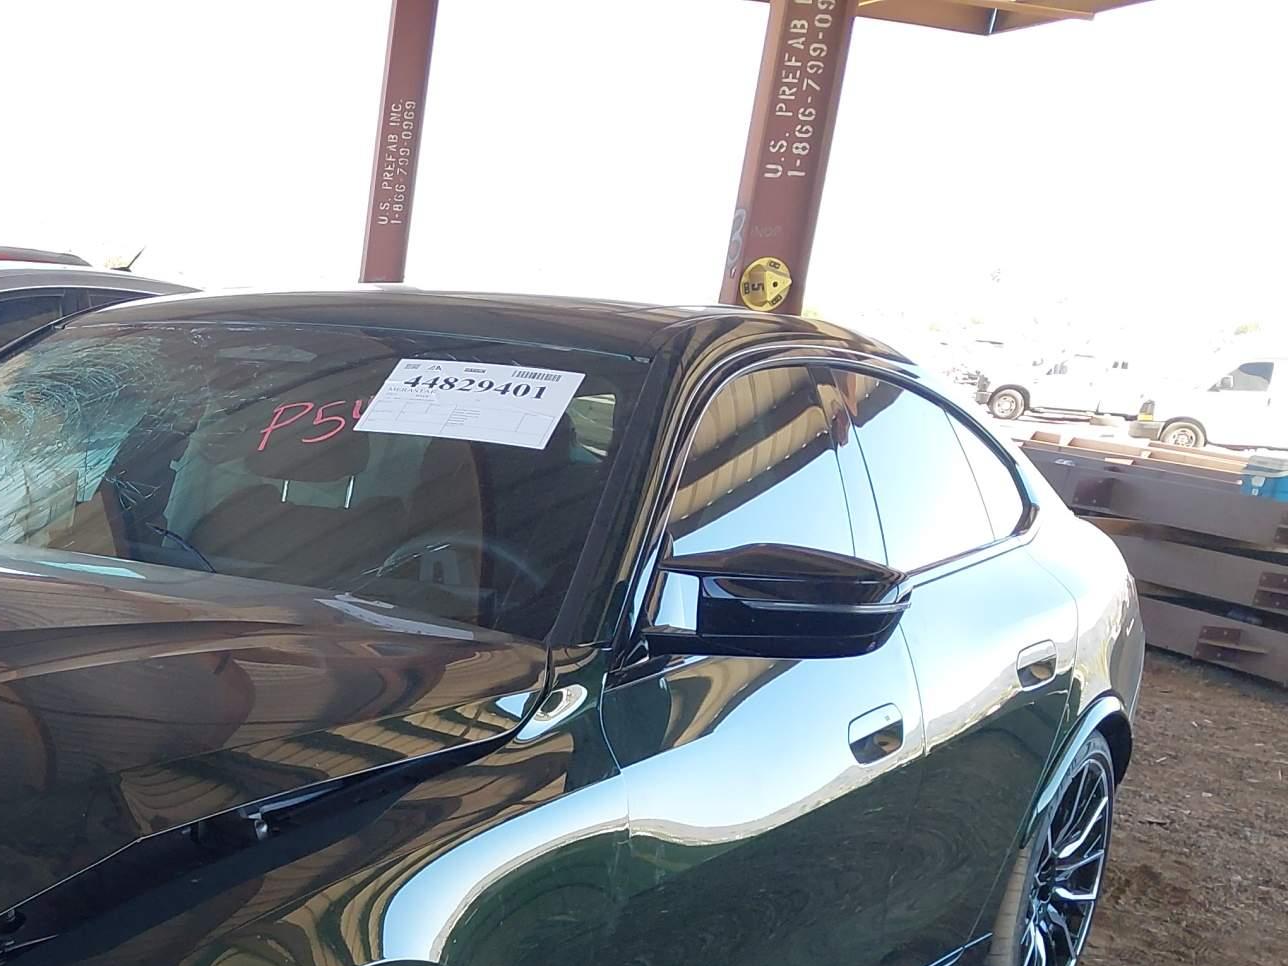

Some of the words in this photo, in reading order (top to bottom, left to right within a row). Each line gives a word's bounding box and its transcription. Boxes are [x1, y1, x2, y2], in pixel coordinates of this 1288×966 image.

[775, 19, 809, 116] PREFAB
[389, 99, 403, 126] INC.
[381, 134, 399, 190] PREFAB
[390, 101, 416, 224] 1-866-799-0969
[764, 132, 790, 178] U.S.
[377, 198, 392, 225] U.S.
[403, 375, 548, 400] 44829401
